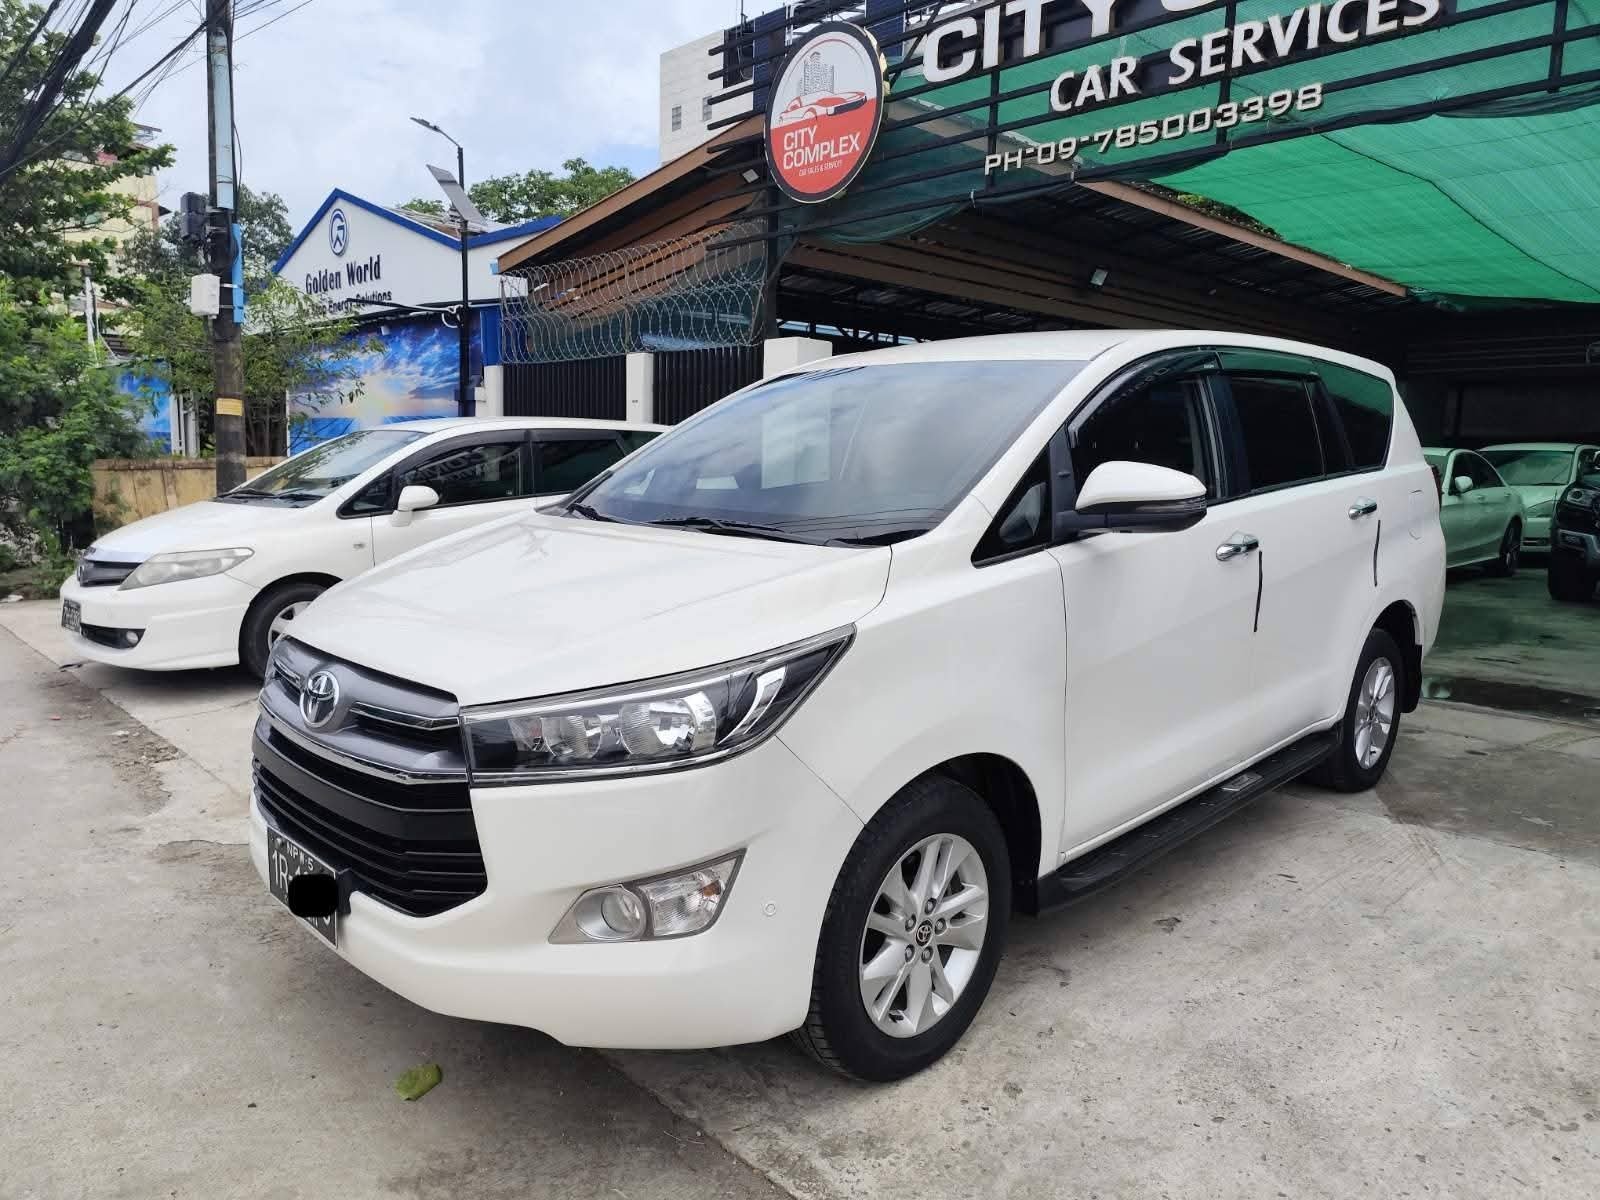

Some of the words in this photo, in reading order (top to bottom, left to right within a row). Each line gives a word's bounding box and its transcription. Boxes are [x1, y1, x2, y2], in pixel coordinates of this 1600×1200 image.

[922, 0, 1116, 83] CITY
[1051, 55, 1139, 112] CAR
[1168, 0, 1441, 85] SERVICES
[783, 125, 818, 151] CITY
[783, 132, 861, 170] COMPLEX
[305, 268, 342, 295] Golden
[346, 254, 381, 287] World
